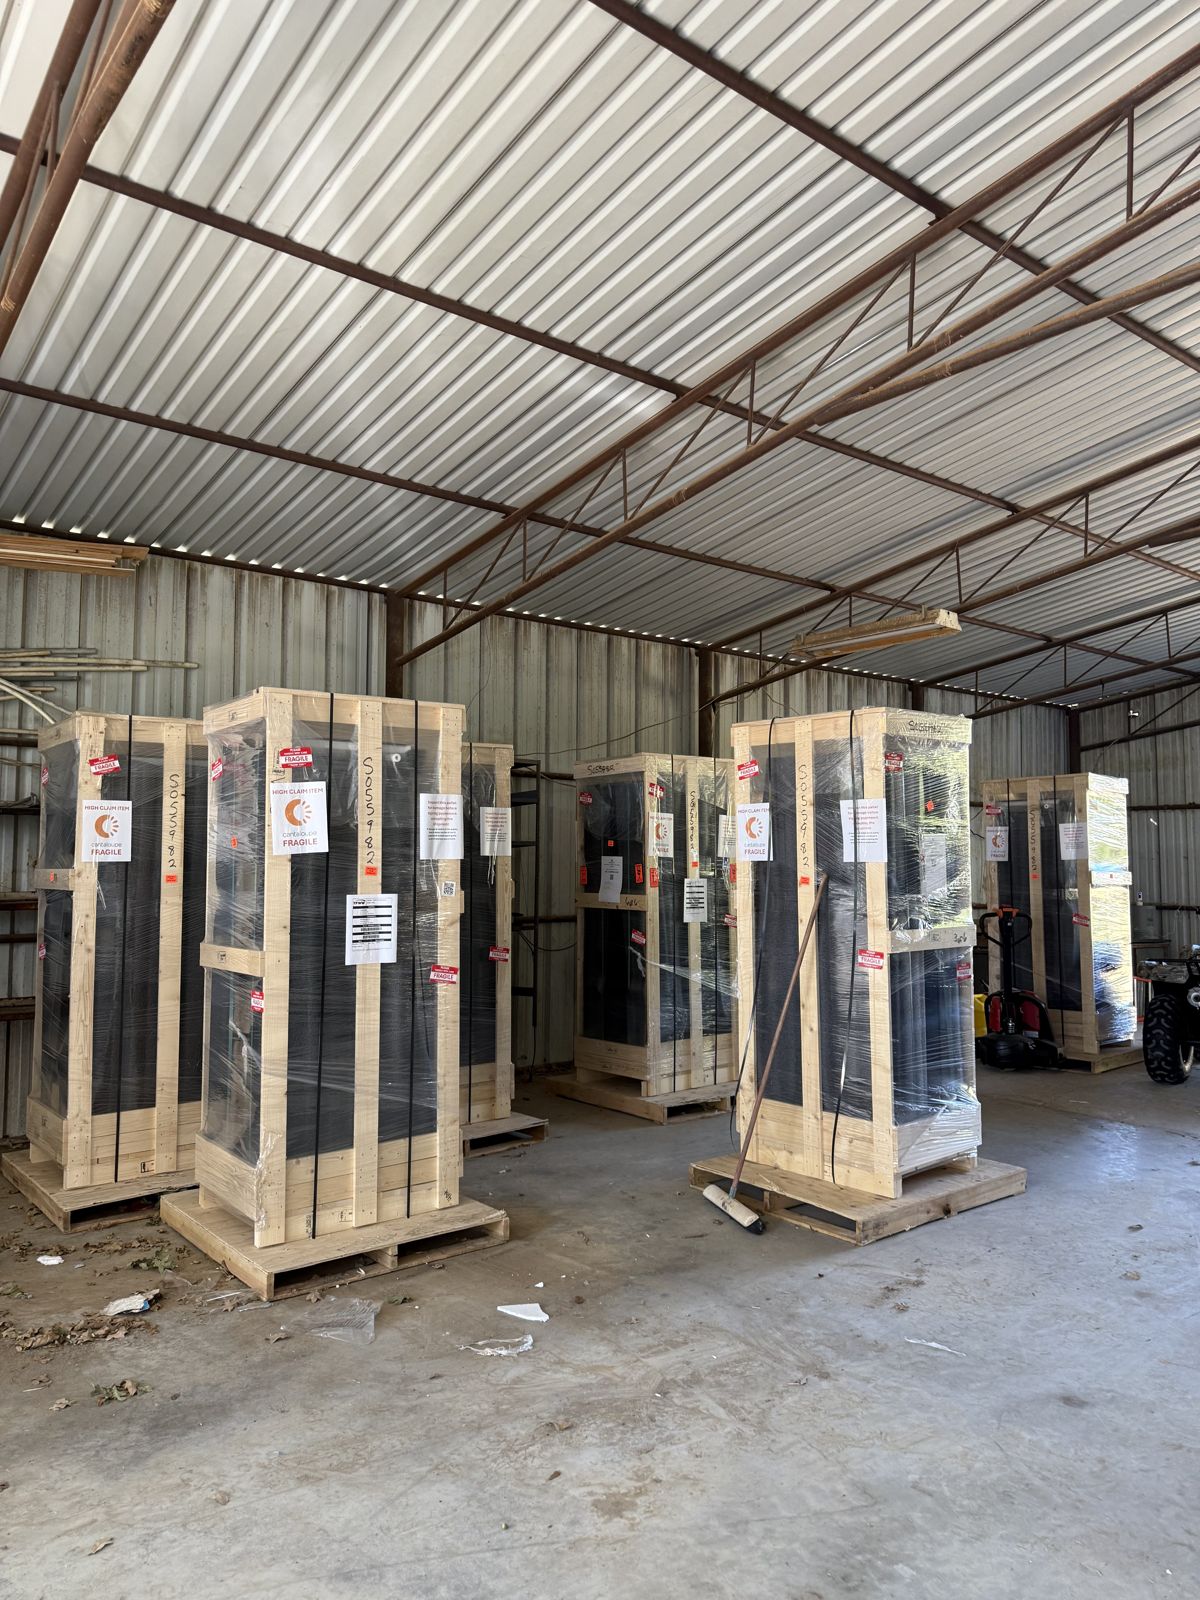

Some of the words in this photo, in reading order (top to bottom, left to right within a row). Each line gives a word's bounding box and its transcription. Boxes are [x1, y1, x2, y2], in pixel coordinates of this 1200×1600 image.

[284, 755, 309, 763] FRAGILE
[94, 761, 117, 770] FRAGILE
[283, 838, 318, 847] FRAGILE
[91, 848, 122, 856] FRAGILE
